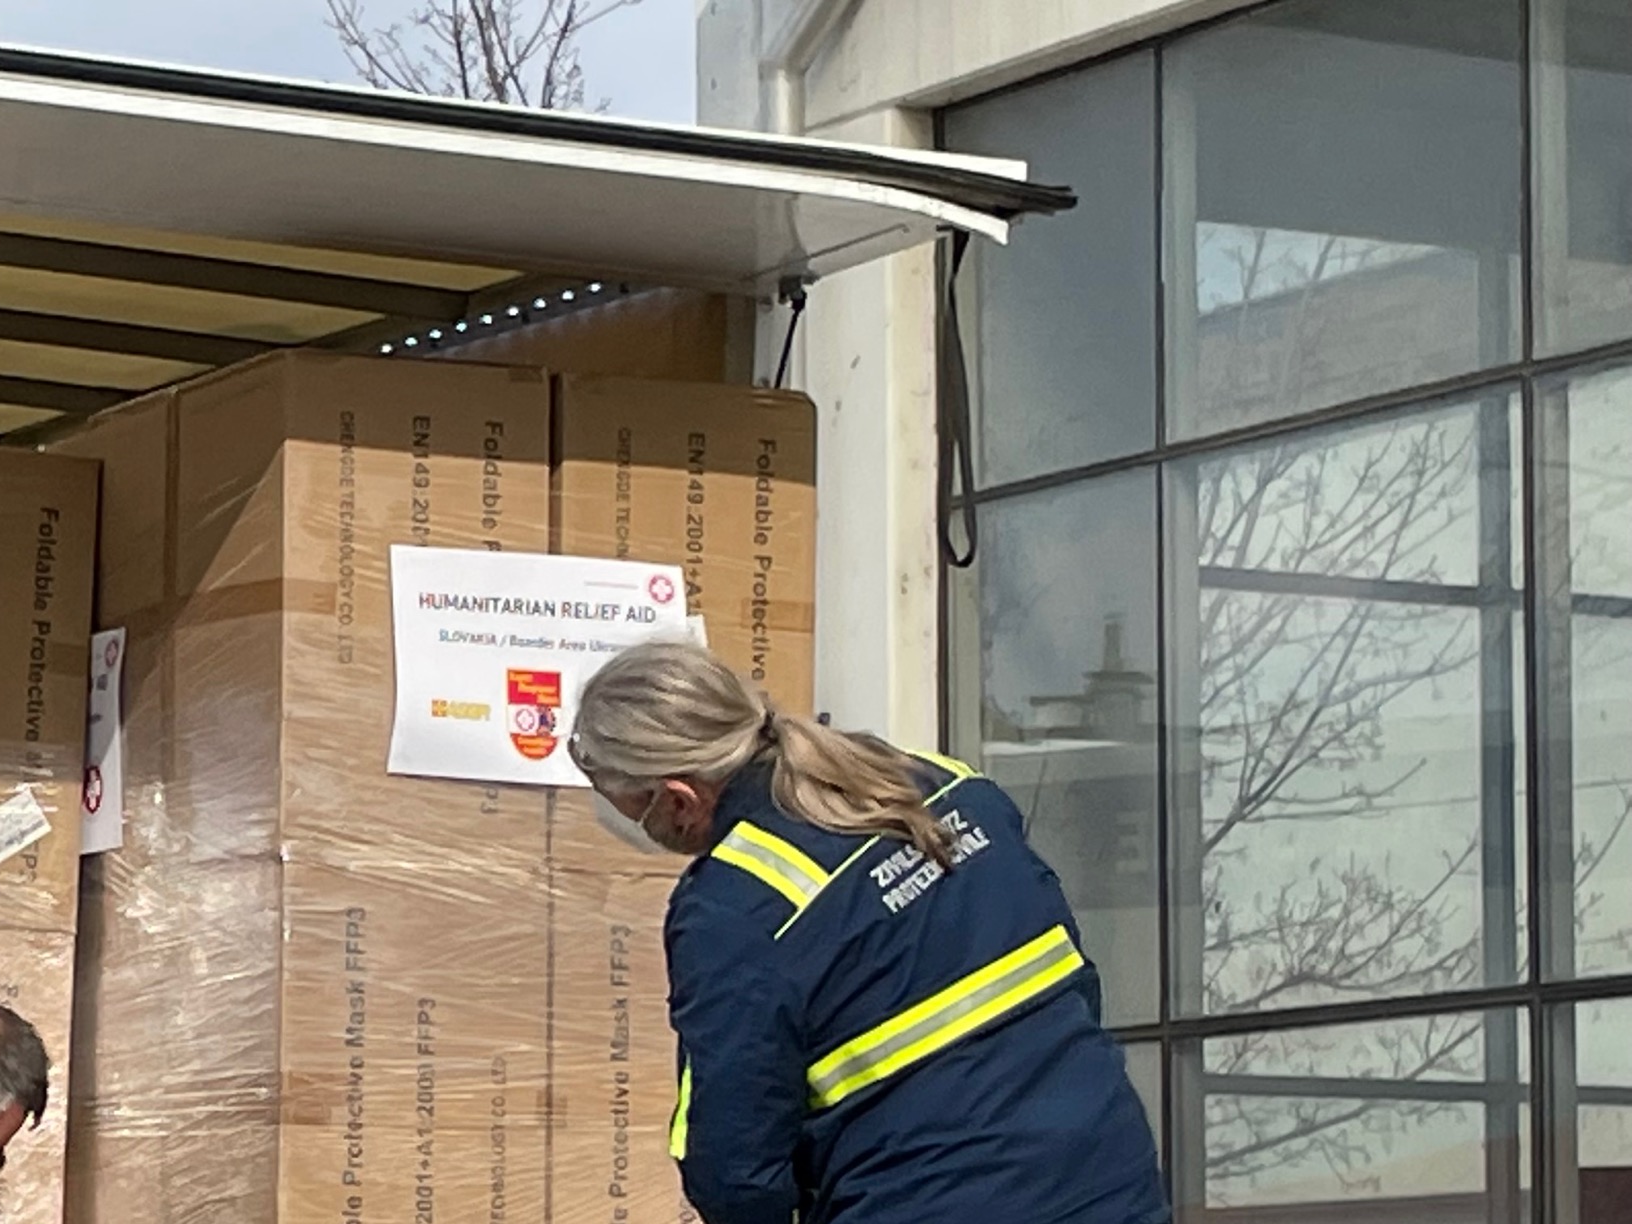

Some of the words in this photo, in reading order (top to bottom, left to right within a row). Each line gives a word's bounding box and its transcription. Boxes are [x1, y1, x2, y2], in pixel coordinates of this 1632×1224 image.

[481, 421, 504, 531] Foldable
[752, 437, 778, 546] Foldable
[33, 506, 60, 611] Foldable
[418, 591, 556, 618] HUMANITARIAN
[560, 601, 621, 621] RELIEF
[625, 605, 657, 624] AID
[750, 555, 775, 682] Protective
[23, 619, 52, 742] Protective
[344, 906, 368, 972] FFP3
[609, 923, 632, 988] FFP3
[344, 980, 367, 1048] Mask
[416, 996, 437, 1056] FFP3
[609, 998, 632, 1062] Mask
[341, 1059, 365, 1187] Protective
[608, 1070, 632, 1199] Protective
